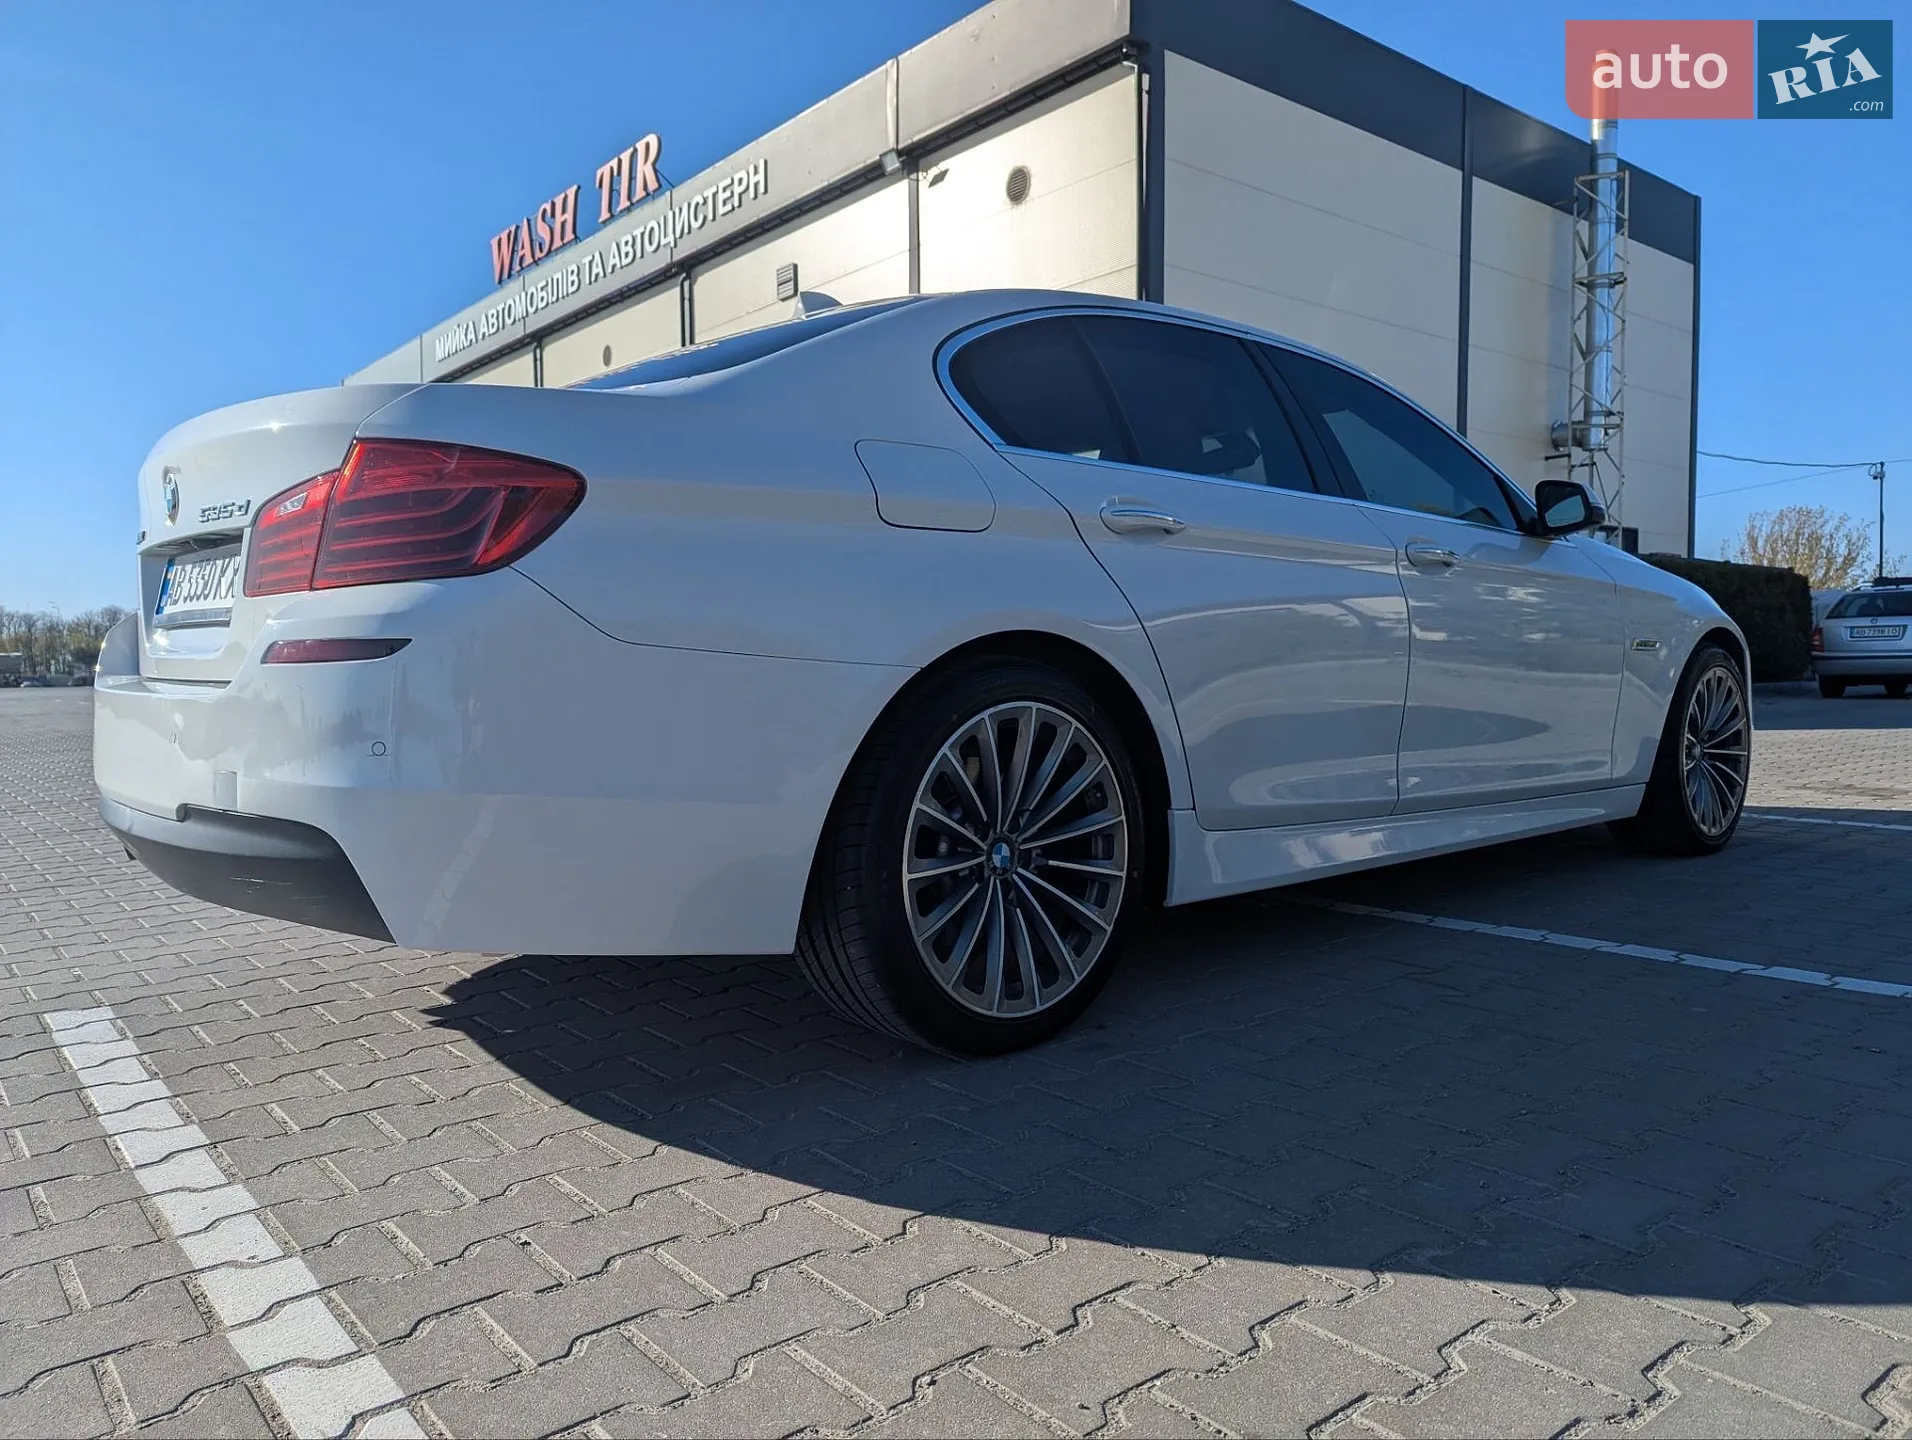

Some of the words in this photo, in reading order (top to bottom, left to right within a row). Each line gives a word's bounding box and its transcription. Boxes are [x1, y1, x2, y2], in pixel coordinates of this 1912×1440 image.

[435, 320, 478, 363] МИЙКА
[479, 263, 580, 341] АВТОМОБІЛІВ
[582, 249, 607, 286] ТА
[608, 158, 767, 274] АВТОЦИСТЕРН
[490, 184, 581, 285] WASH
[596, 133, 661, 224] TIR
